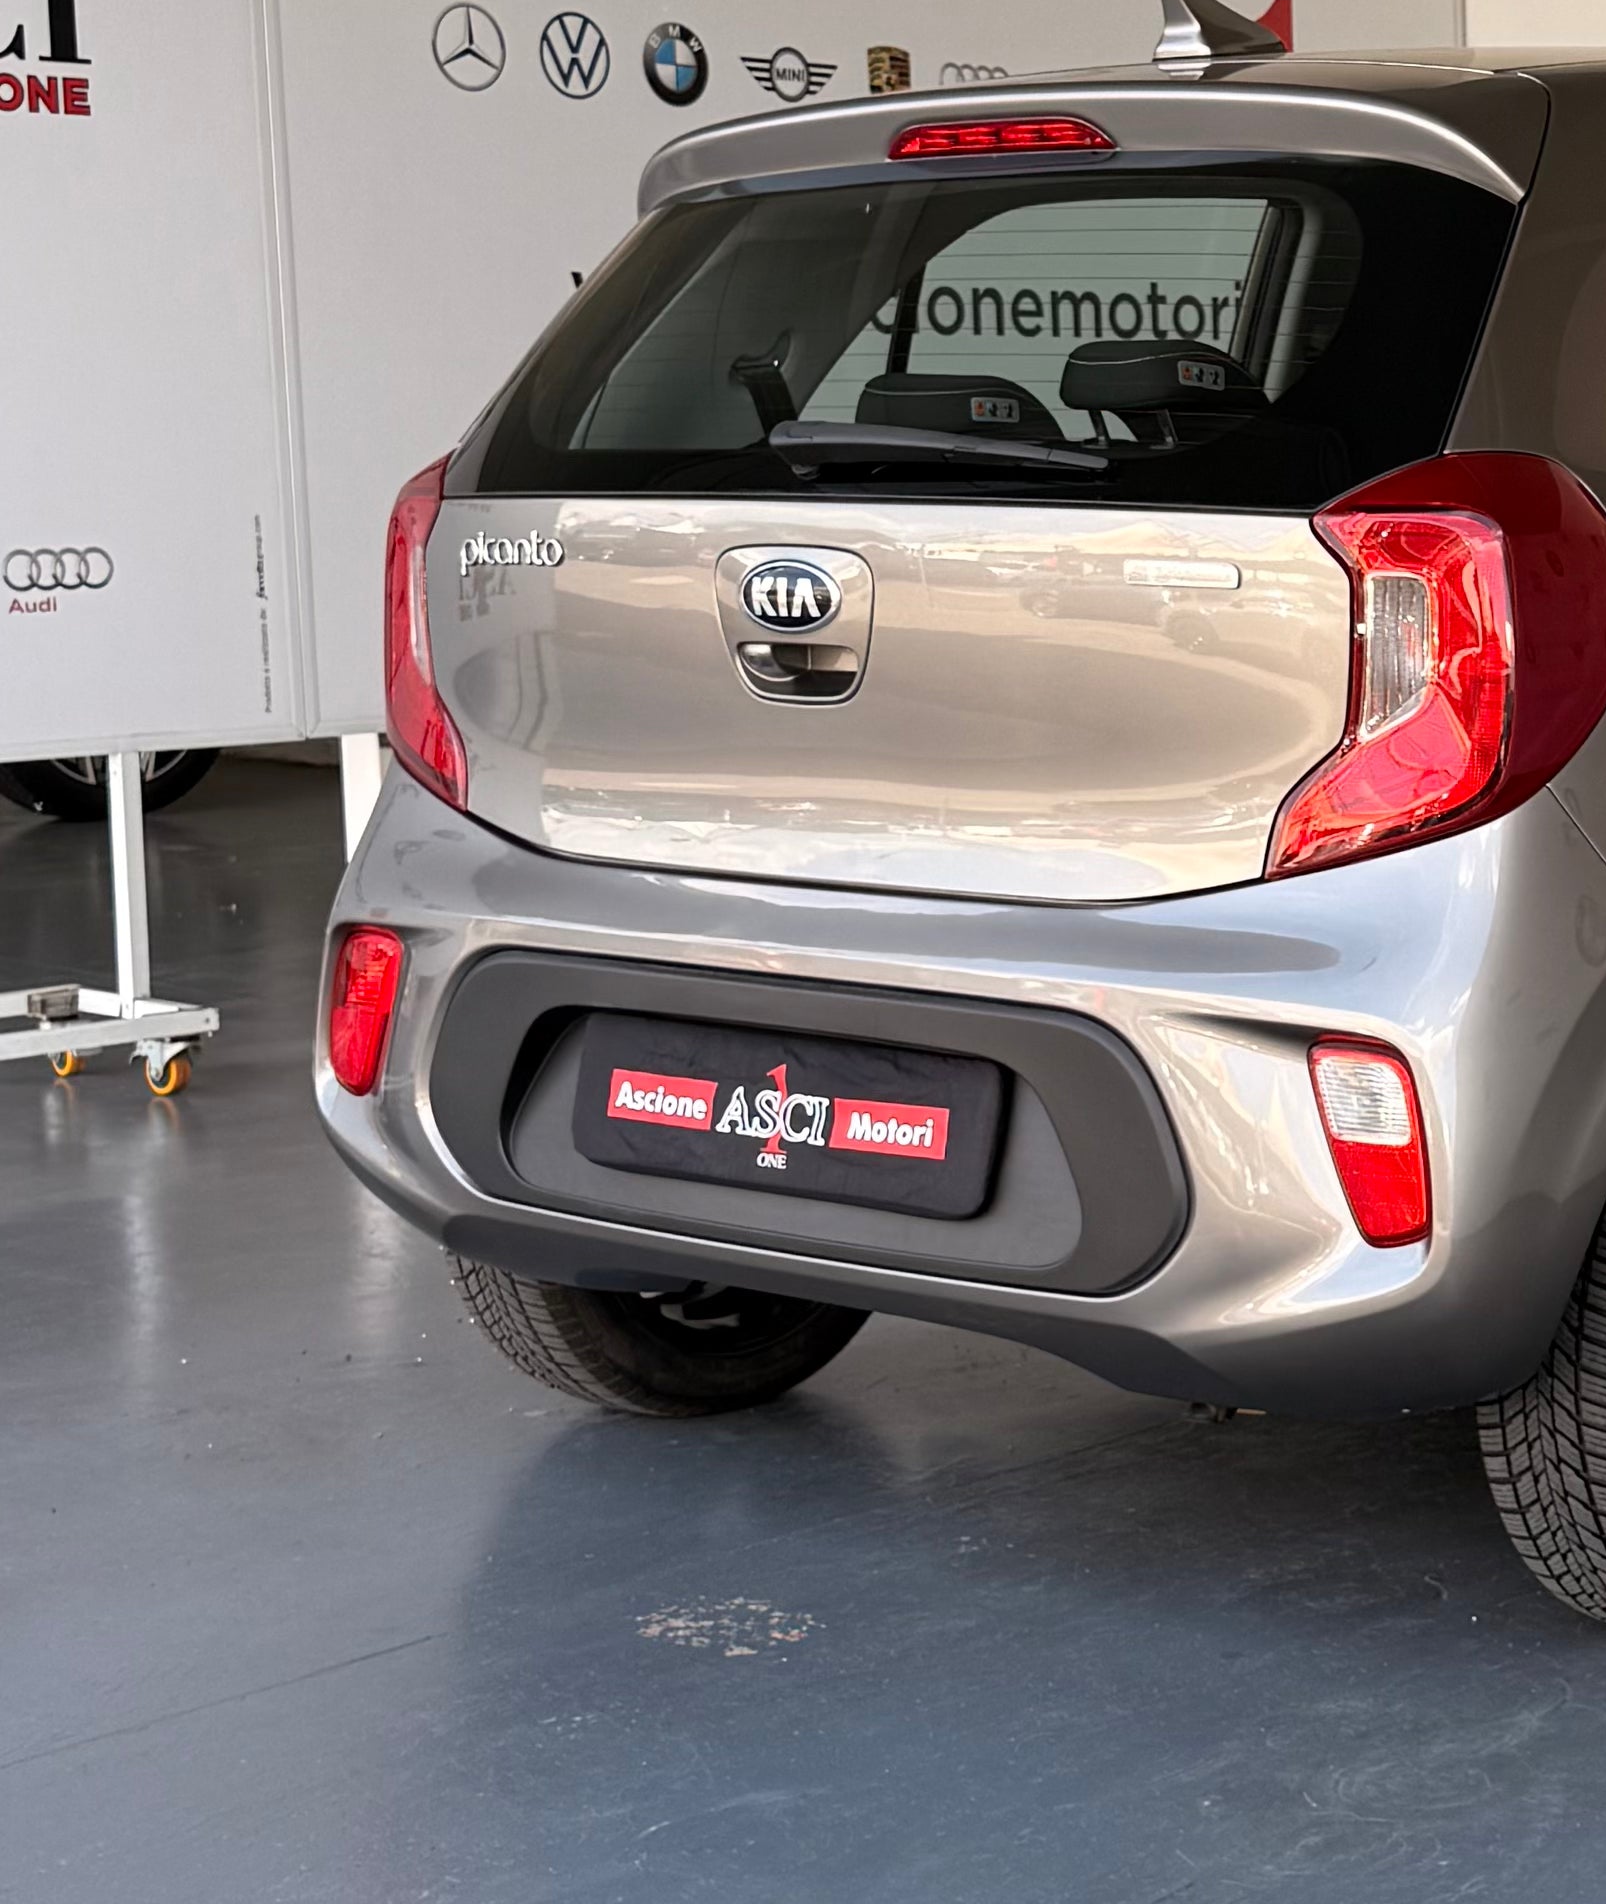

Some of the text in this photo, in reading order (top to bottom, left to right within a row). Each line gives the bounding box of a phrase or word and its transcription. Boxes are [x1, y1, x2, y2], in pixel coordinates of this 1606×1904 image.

[649, 23, 703, 53] BMW
[776, 68, 806, 82] MINI
[0, 72, 91, 116] ONE
[460, 529, 566, 577] picanto
[9, 596, 57, 614] Audi
[752, 576, 821, 619] KIA
[615, 1080, 933, 1148] Ascione ASCI Motori
[756, 1152, 787, 1170] ONE
